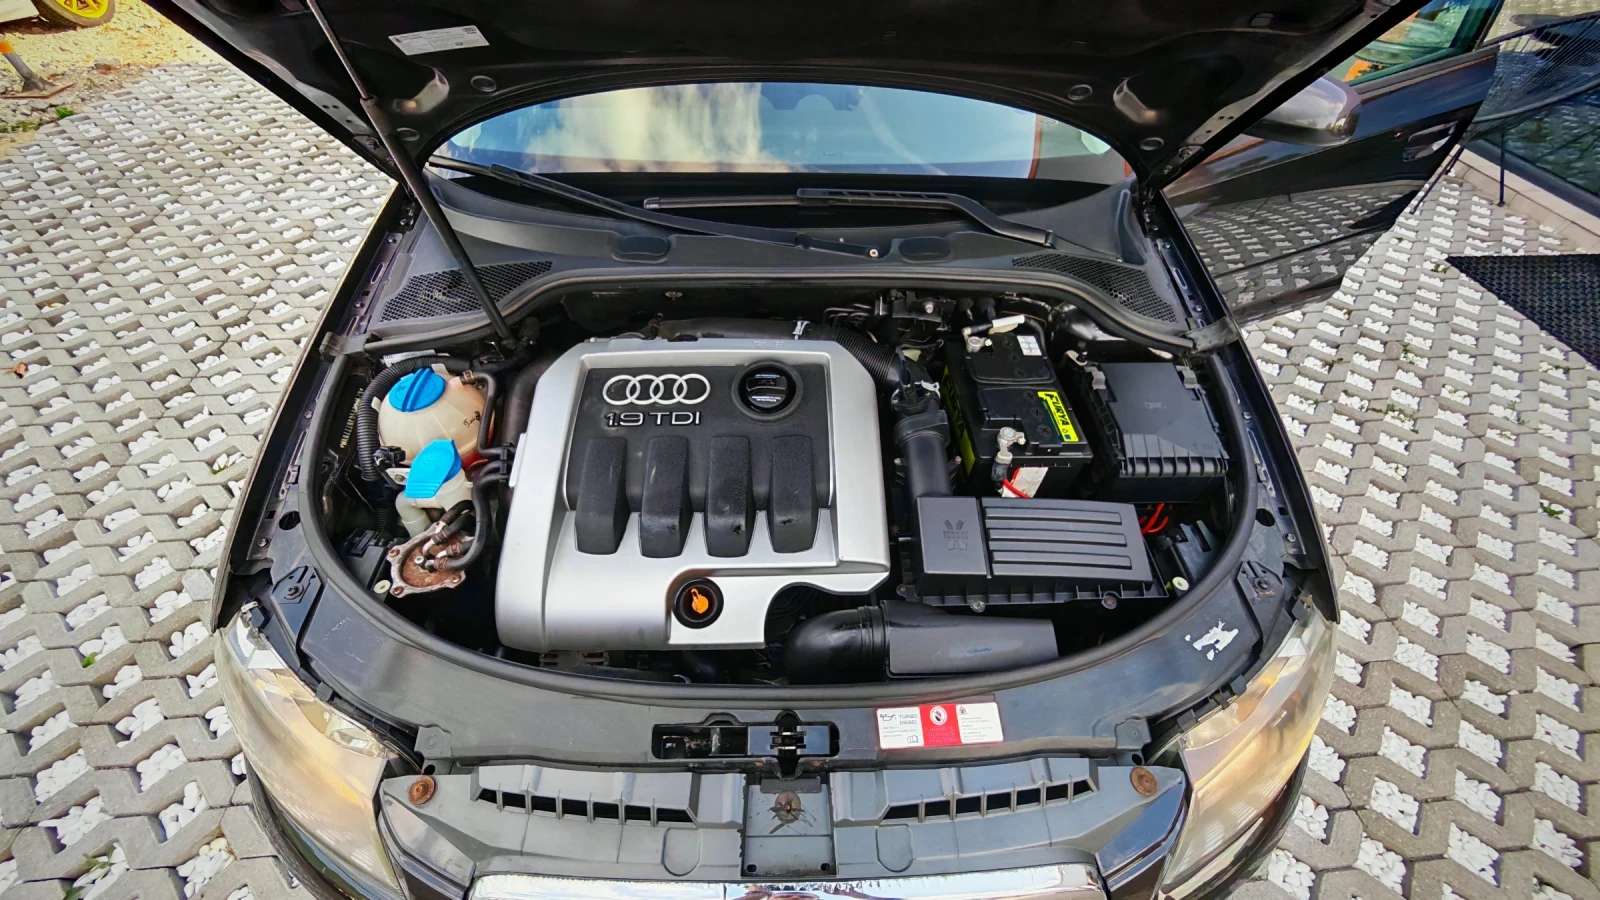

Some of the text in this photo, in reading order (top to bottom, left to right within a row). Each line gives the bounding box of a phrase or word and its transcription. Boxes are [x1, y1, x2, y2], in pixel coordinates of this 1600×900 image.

[606, 411, 700, 426] 1.9 TDI
[1045, 393, 1069, 426] FURYA
